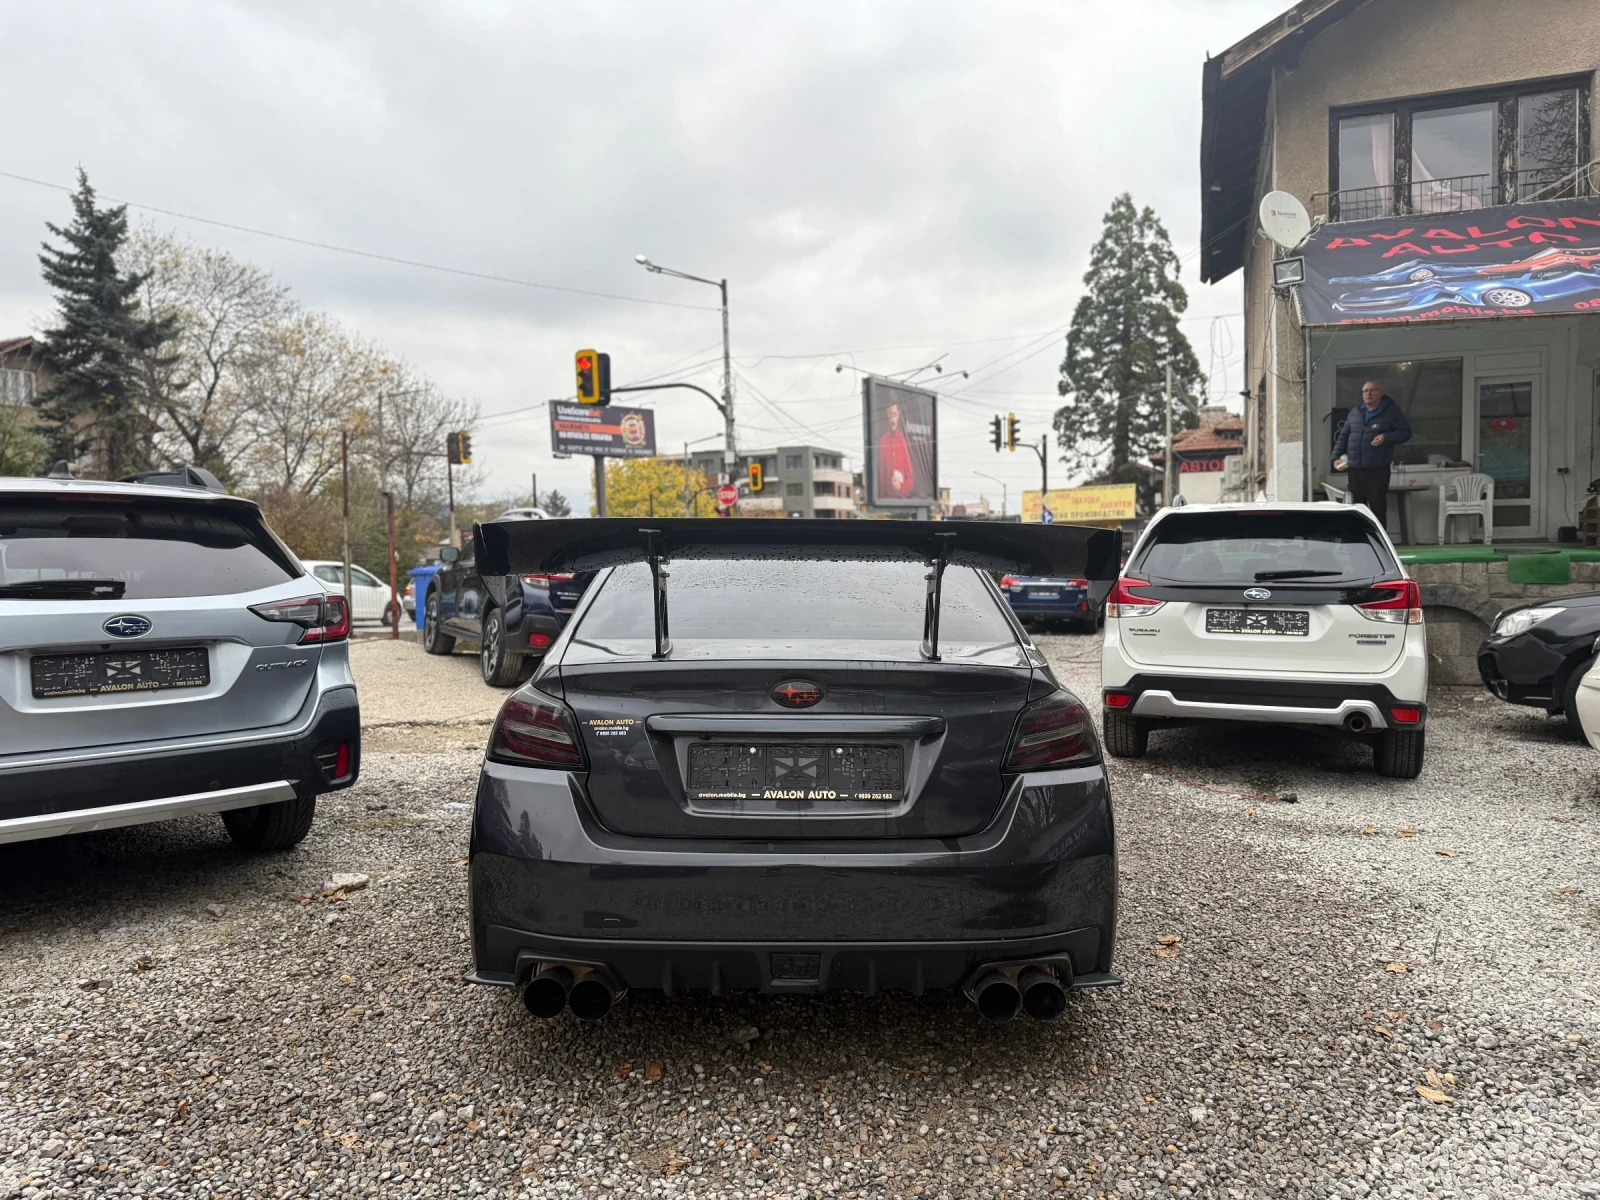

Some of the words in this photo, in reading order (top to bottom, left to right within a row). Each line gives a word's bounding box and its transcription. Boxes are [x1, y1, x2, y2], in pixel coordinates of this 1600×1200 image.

[1179, 459, 1225, 473] АВТО
[256, 659, 308, 671] OUTBACK
[100, 683, 134, 692] AVALON
[137, 681, 160, 689] AUTO
[698, 792, 747, 800] avalon.mobile.bg
[763, 790, 804, 799] AVALON
[808, 790, 837, 799] AUTO
